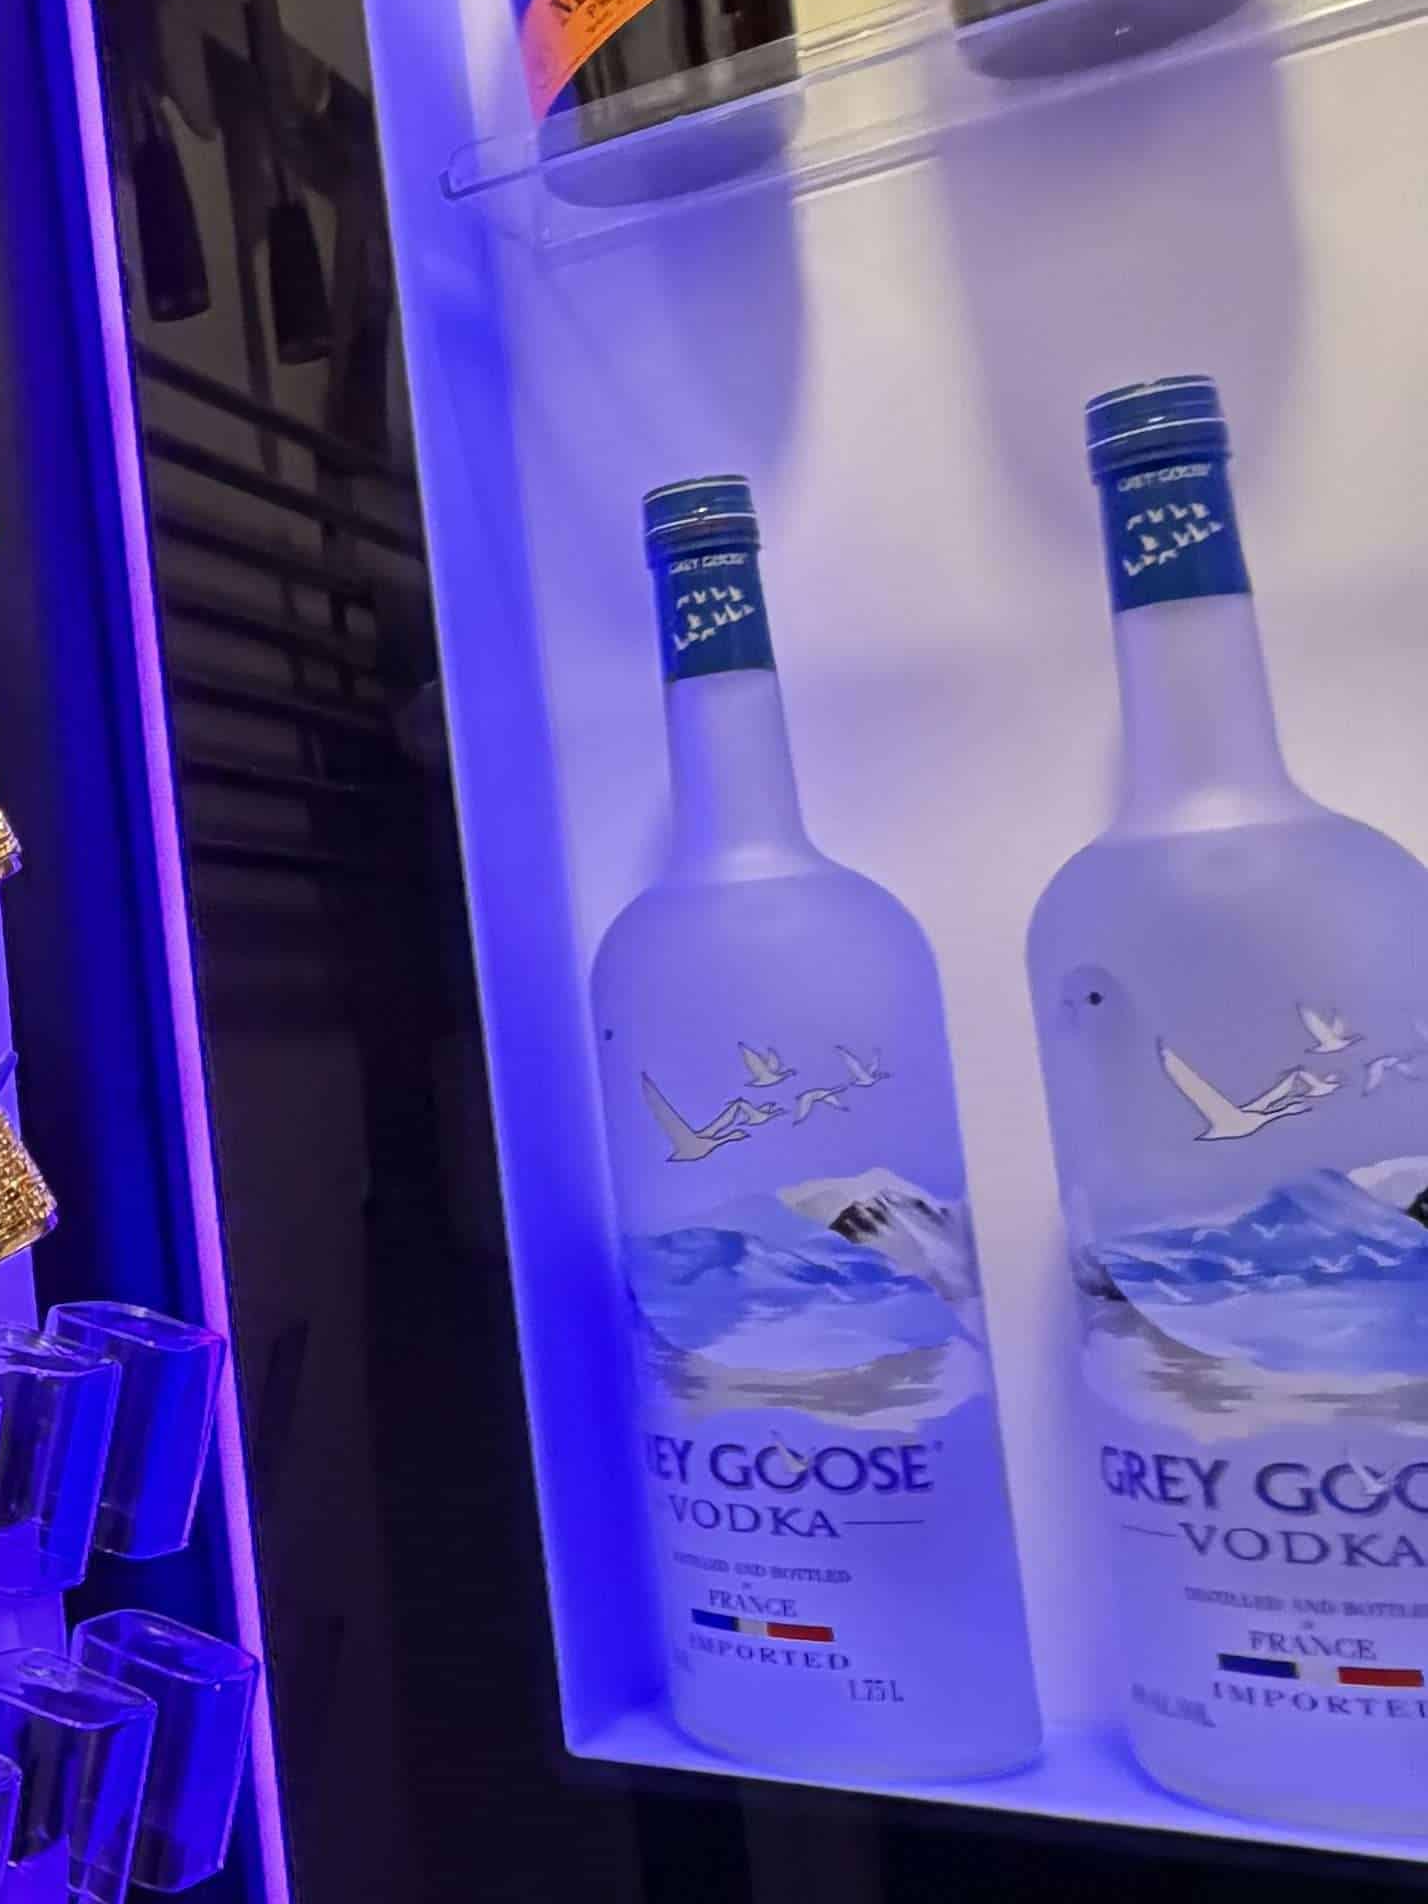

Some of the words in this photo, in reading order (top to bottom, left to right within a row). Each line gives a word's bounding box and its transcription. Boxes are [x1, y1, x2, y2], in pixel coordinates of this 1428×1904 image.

[709, 1442, 935, 1496] GOOSE
[1100, 1445, 1230, 1511] GREY
[668, 1494, 841, 1539] VODKA
[1177, 1521, 1428, 1568] VODKA
[708, 1588, 798, 1617] FRANCE
[688, 1631, 850, 1671] IMPORTED
[1247, 1630, 1378, 1661] FRANCE
